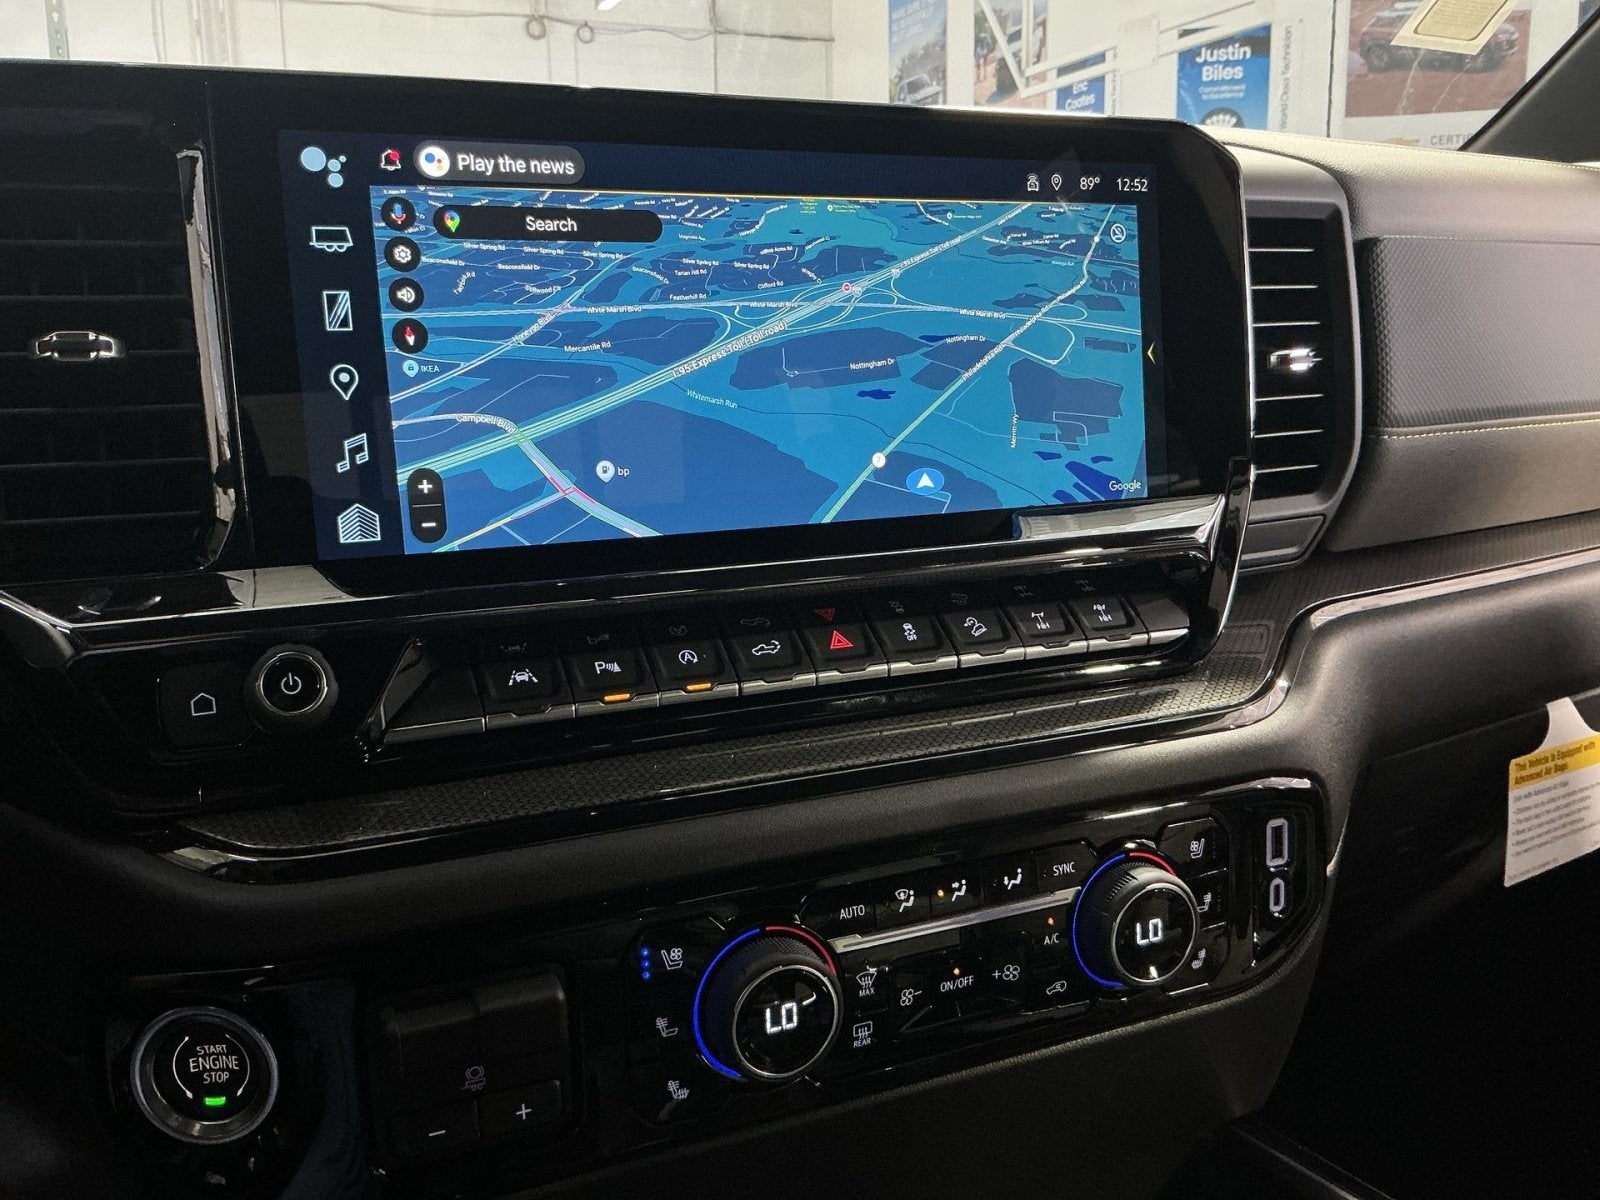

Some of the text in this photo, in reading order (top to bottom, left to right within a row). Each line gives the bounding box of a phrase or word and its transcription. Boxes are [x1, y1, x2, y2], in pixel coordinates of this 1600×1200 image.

[1195, 42, 1251, 63] Justin
[1202, 64, 1244, 81] Biles
[457, 154, 575, 176] Play the news
[1080, 176, 1101, 190] 89°
[1116, 178, 1148, 192] 12:52
[525, 215, 578, 232] Search
[480, 243, 498, 251] Spring
[540, 247, 557, 255] Spring
[583, 250, 624, 260] Silver Spring Rd
[459, 259, 466, 267] Dr
[669, 293, 698, 301] Featherhill
[627, 304, 643, 313] Blvd
[692, 348, 727, 369] Express
[727, 340, 745, 354] Toll
[744, 330, 764, 347] (Toll
[764, 319, 788, 335] road)
[945, 334, 986, 344] Nottingham Dr
[564, 340, 611, 353] Mercantile Rd
[421, 364, 440, 373] IKEA
[849, 358, 895, 370] Nottingham Dr
[687, 389, 738, 409] Whitemarsh Run
[456, 413, 517, 434] Campbell Blvd
[618, 466, 630, 477] bp
[1109, 480, 1142, 493] Google
[1053, 861, 1076, 876] SYNC
[839, 904, 865, 920] AUTO
[1136, 917, 1163, 946] LO
[1043, 933, 1060, 945] A/C
[940, 975, 974, 992] ON/OFF
[859, 986, 876, 997] MAX
[765, 1001, 798, 1035] LO
[853, 1037, 872, 1048] REAR
[196, 1044, 227, 1055] START
[189, 1055, 240, 1072] ENGINE
[203, 1071, 230, 1084] STOP
